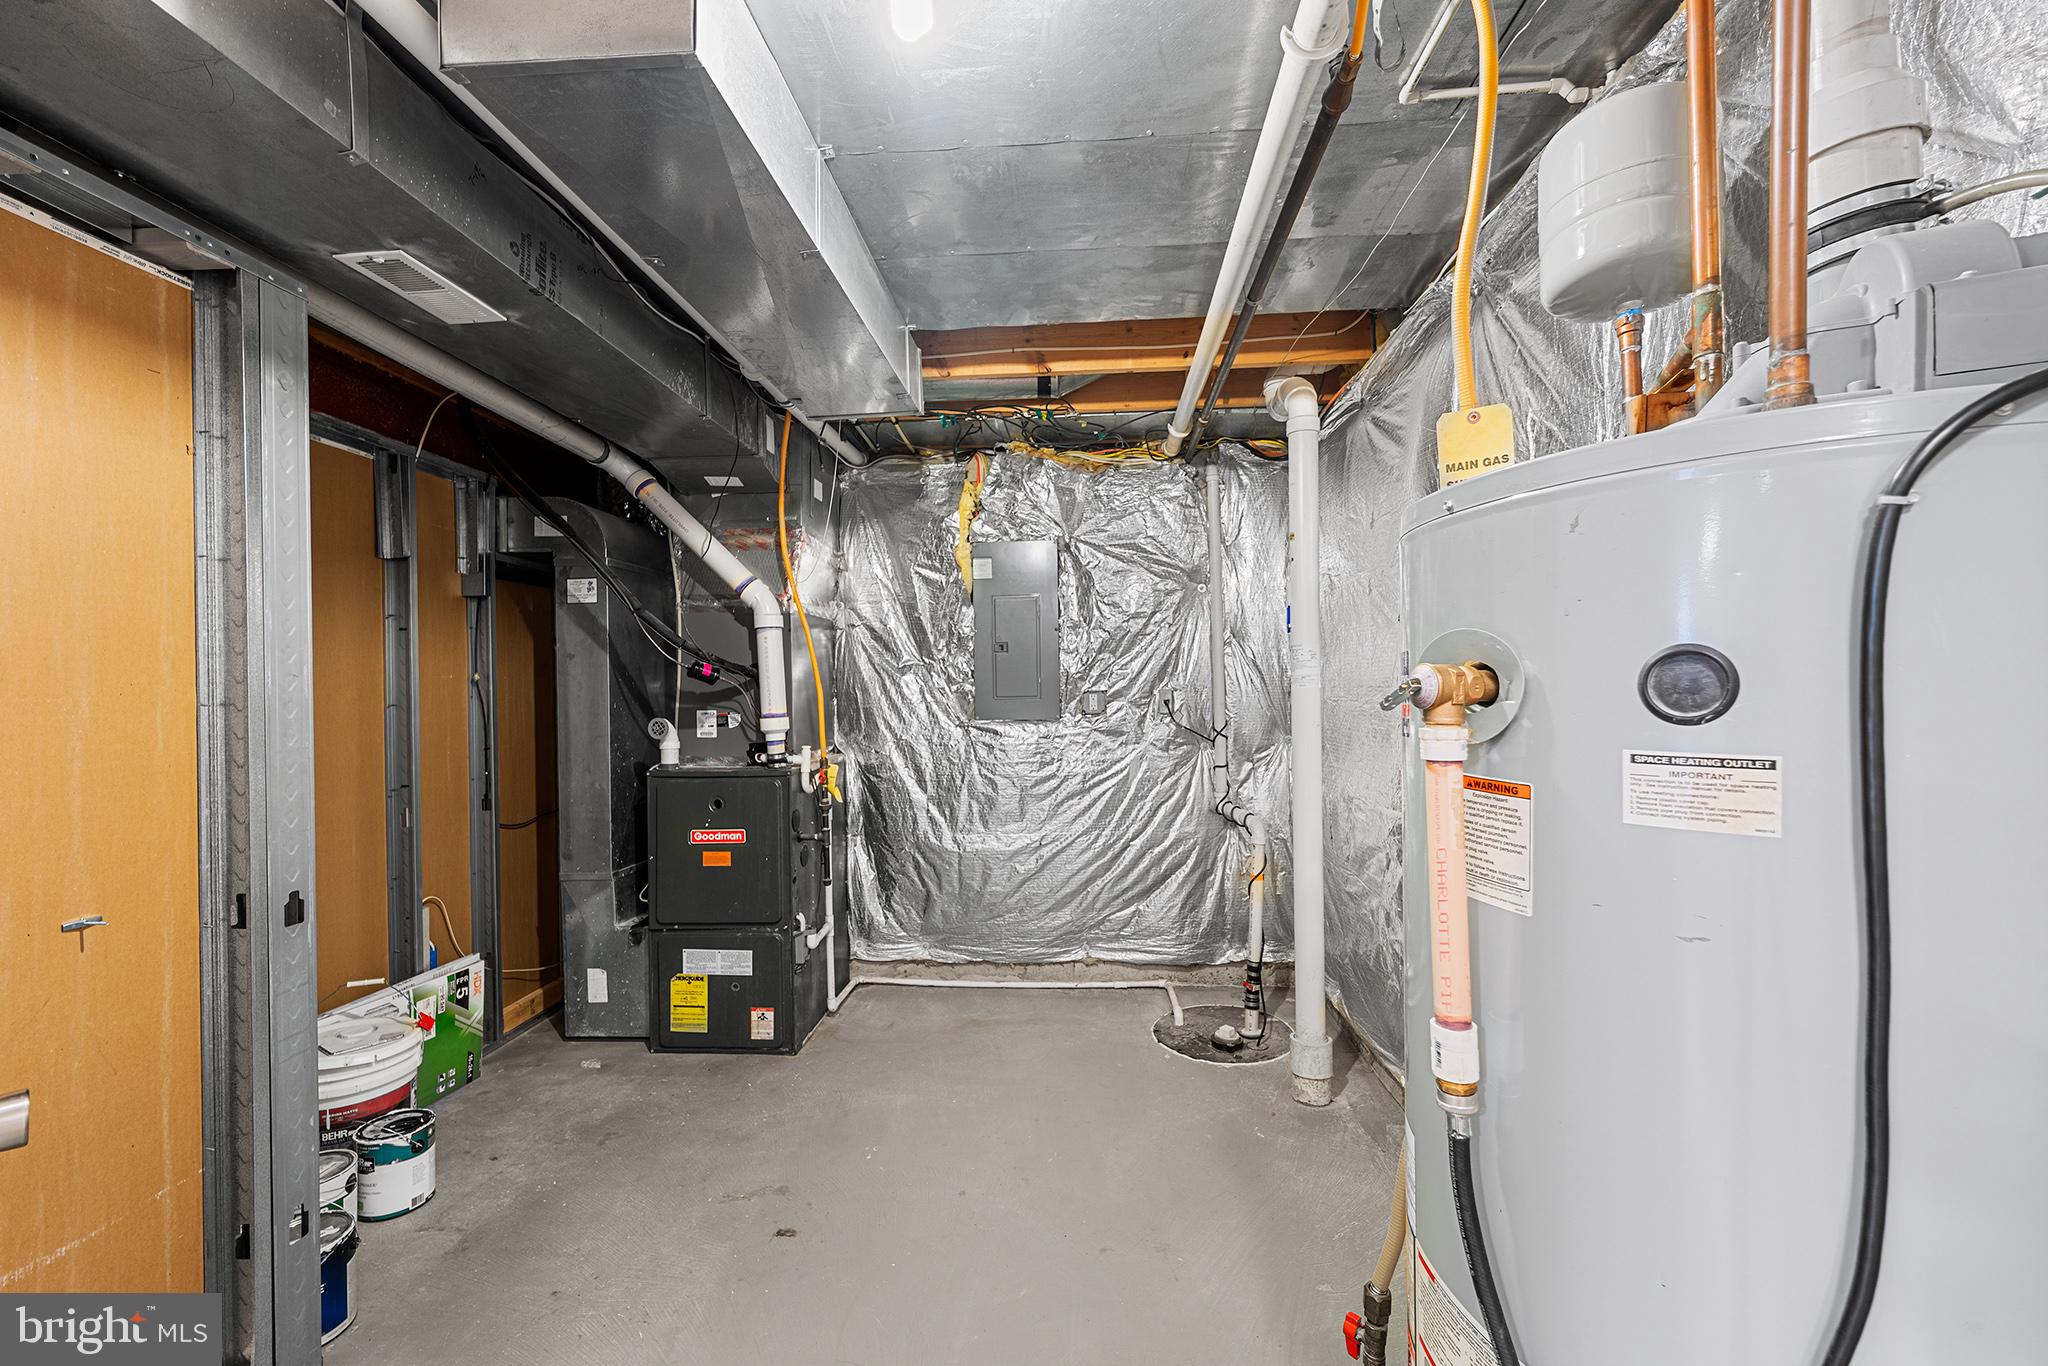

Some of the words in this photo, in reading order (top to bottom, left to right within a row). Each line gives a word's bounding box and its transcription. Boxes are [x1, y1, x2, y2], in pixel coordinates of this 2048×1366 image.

[1445, 459, 1479, 473] MAIN
[1482, 454, 1510, 467] GAS
[1634, 755, 1669, 764] SPACE
[1671, 757, 1722, 767] HEATING
[1723, 759, 1772, 769] OUTLET
[1668, 770, 1734, 781] IMPORTANT
[1473, 780, 1518, 795] WARNING
[693, 831, 742, 841] Goodman
[1436, 847, 1451, 962] CHARLOTTE
[456, 988, 469, 1000] 5
[321, 1129, 348, 1142] BEHR
